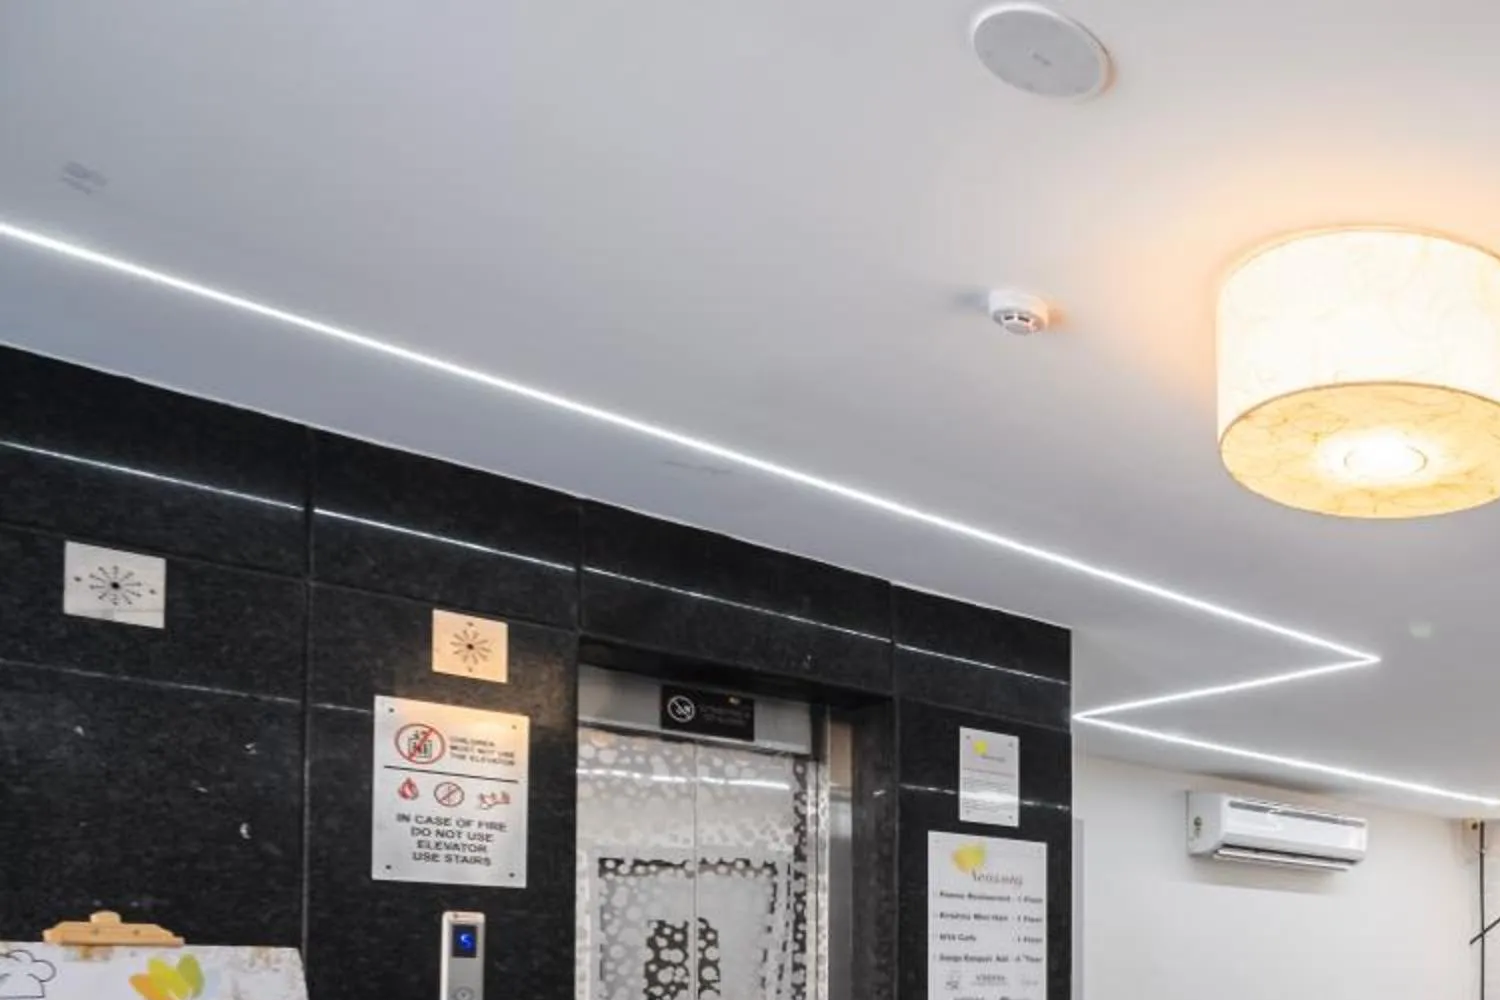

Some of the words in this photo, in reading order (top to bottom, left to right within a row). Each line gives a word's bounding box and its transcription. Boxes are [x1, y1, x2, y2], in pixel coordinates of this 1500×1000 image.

[396, 813, 410, 823] IN
[415, 814, 452, 827] CASE
[456, 817, 476, 829] OF
[478, 820, 507, 833] FIRE
[411, 826, 431, 837] DO
[435, 828, 463, 840] NOT
[467, 832, 495, 843] USE
[417, 839, 487, 854] ELEVATOR
[412, 851, 440, 863] USE
[444, 854, 492, 867] STAIRS
